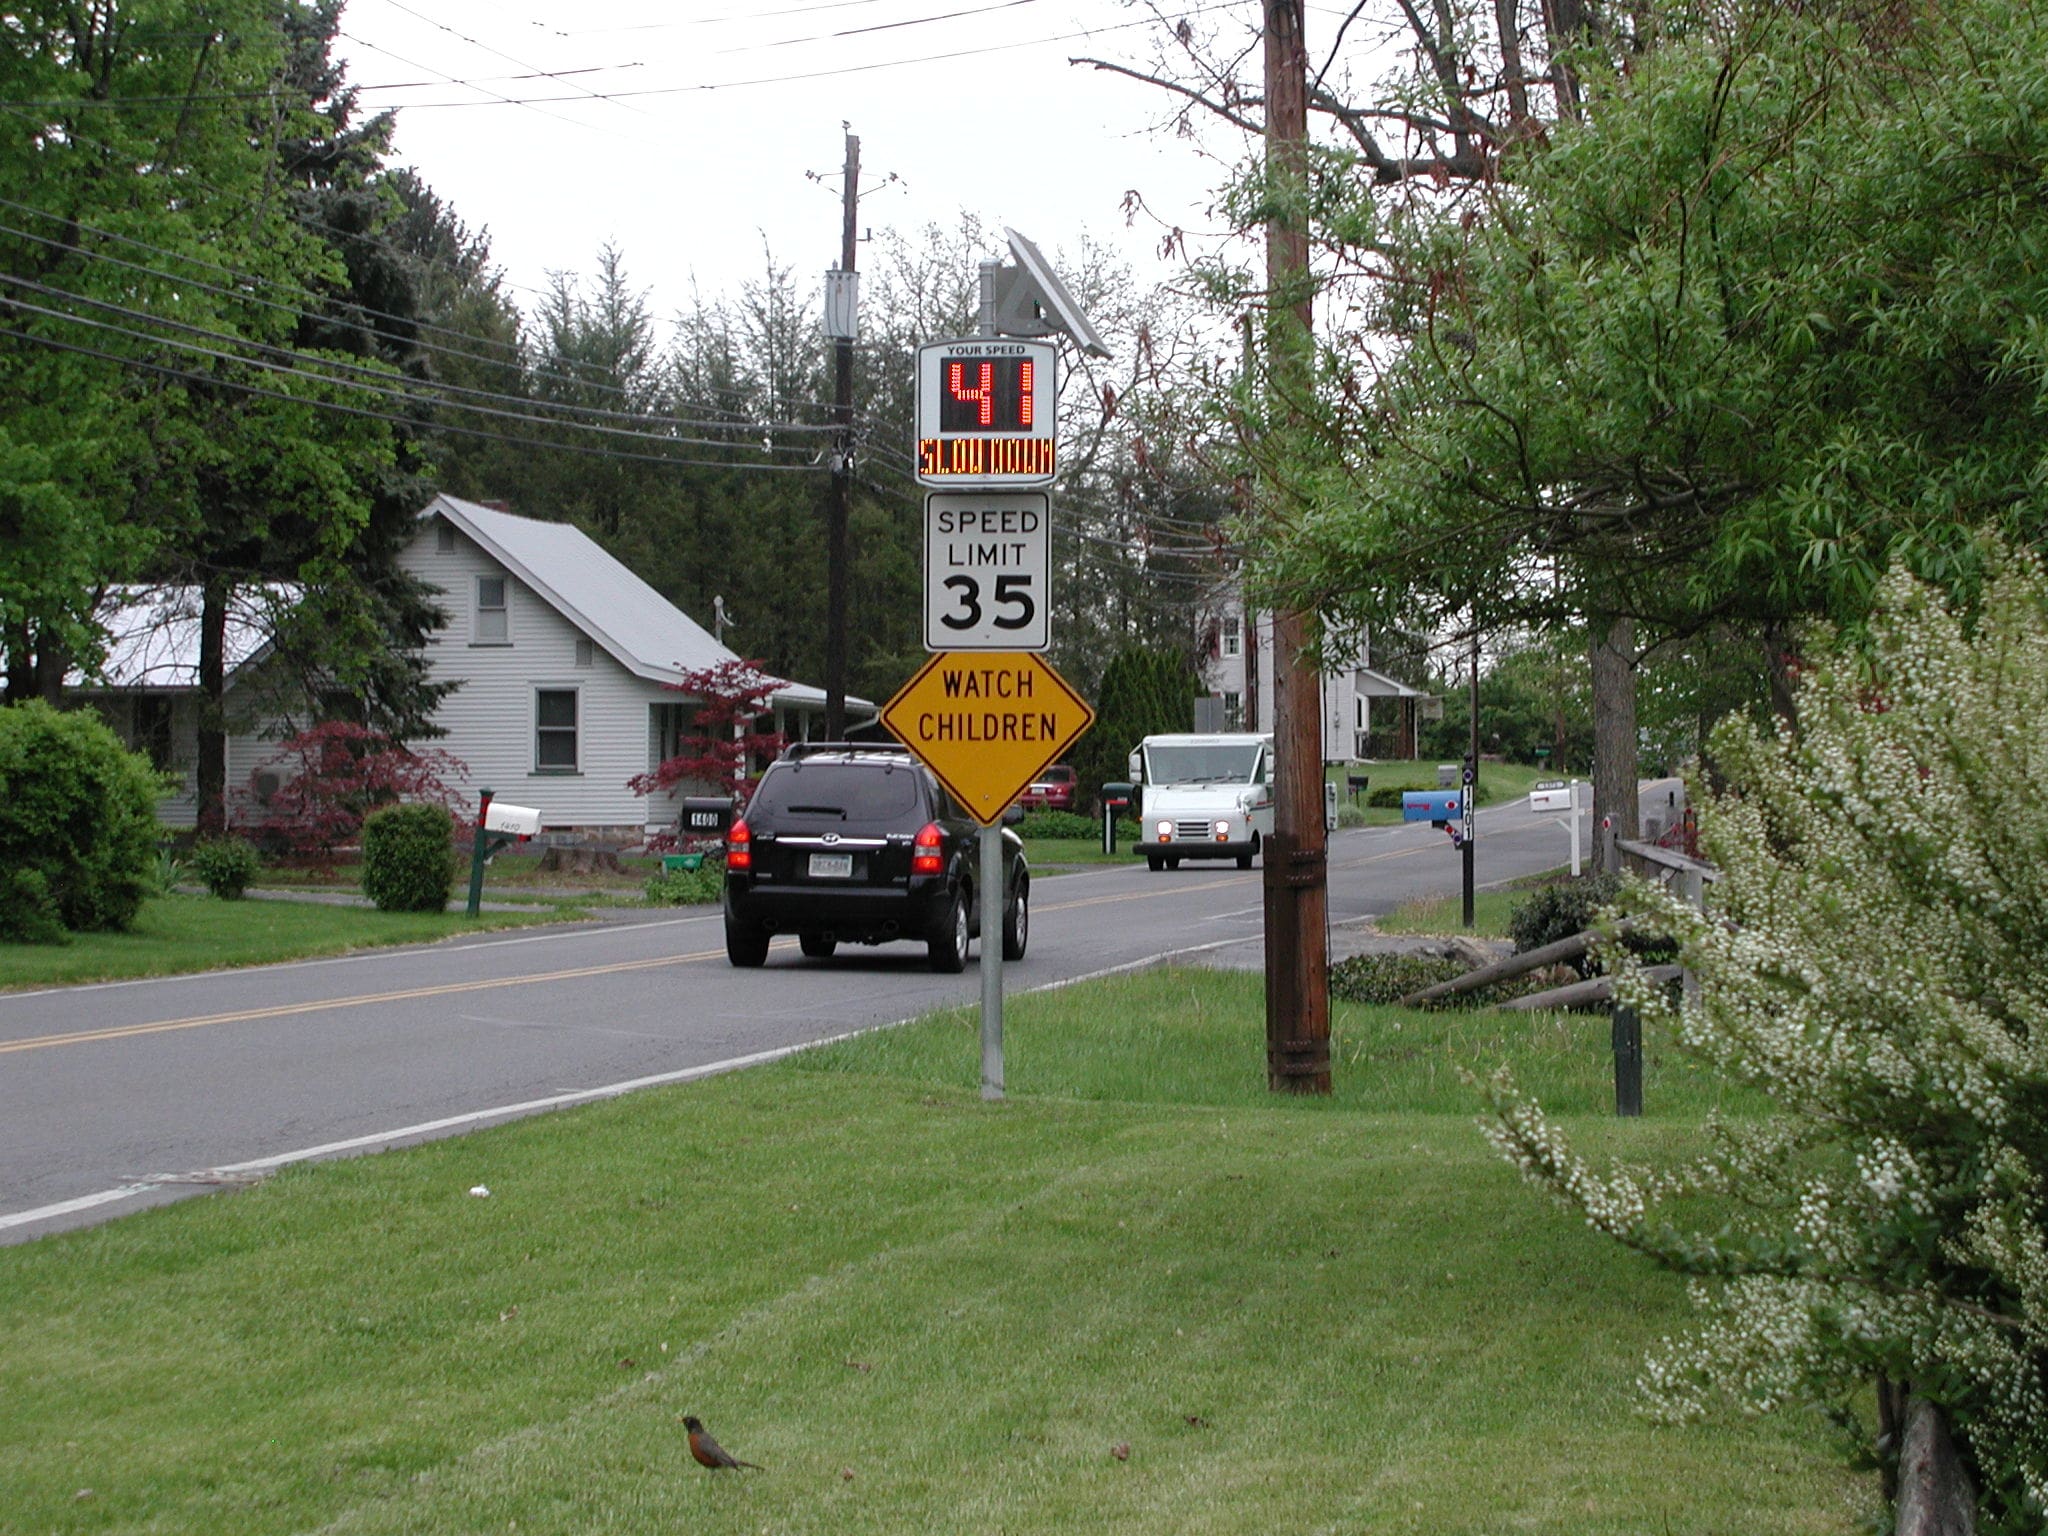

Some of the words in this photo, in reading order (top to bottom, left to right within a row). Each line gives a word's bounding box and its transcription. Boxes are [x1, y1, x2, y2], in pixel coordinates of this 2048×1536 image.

[948, 345, 980, 355] YOUR
[986, 345, 1025, 354] SPEED
[951, 363, 1031, 424] 41
[920, 439, 982, 473] SLOW
[991, 439, 1053, 473] DOWN
[938, 511, 1038, 533] SPEED
[949, 543, 1026, 566] LIMIT
[940, 574, 1035, 630] 35
[943, 670, 1033, 698] WATCH
[919, 713, 1056, 741] CHILDREN
[692, 813, 718, 826] 1400
[1463, 786, 1472, 839] 1401
